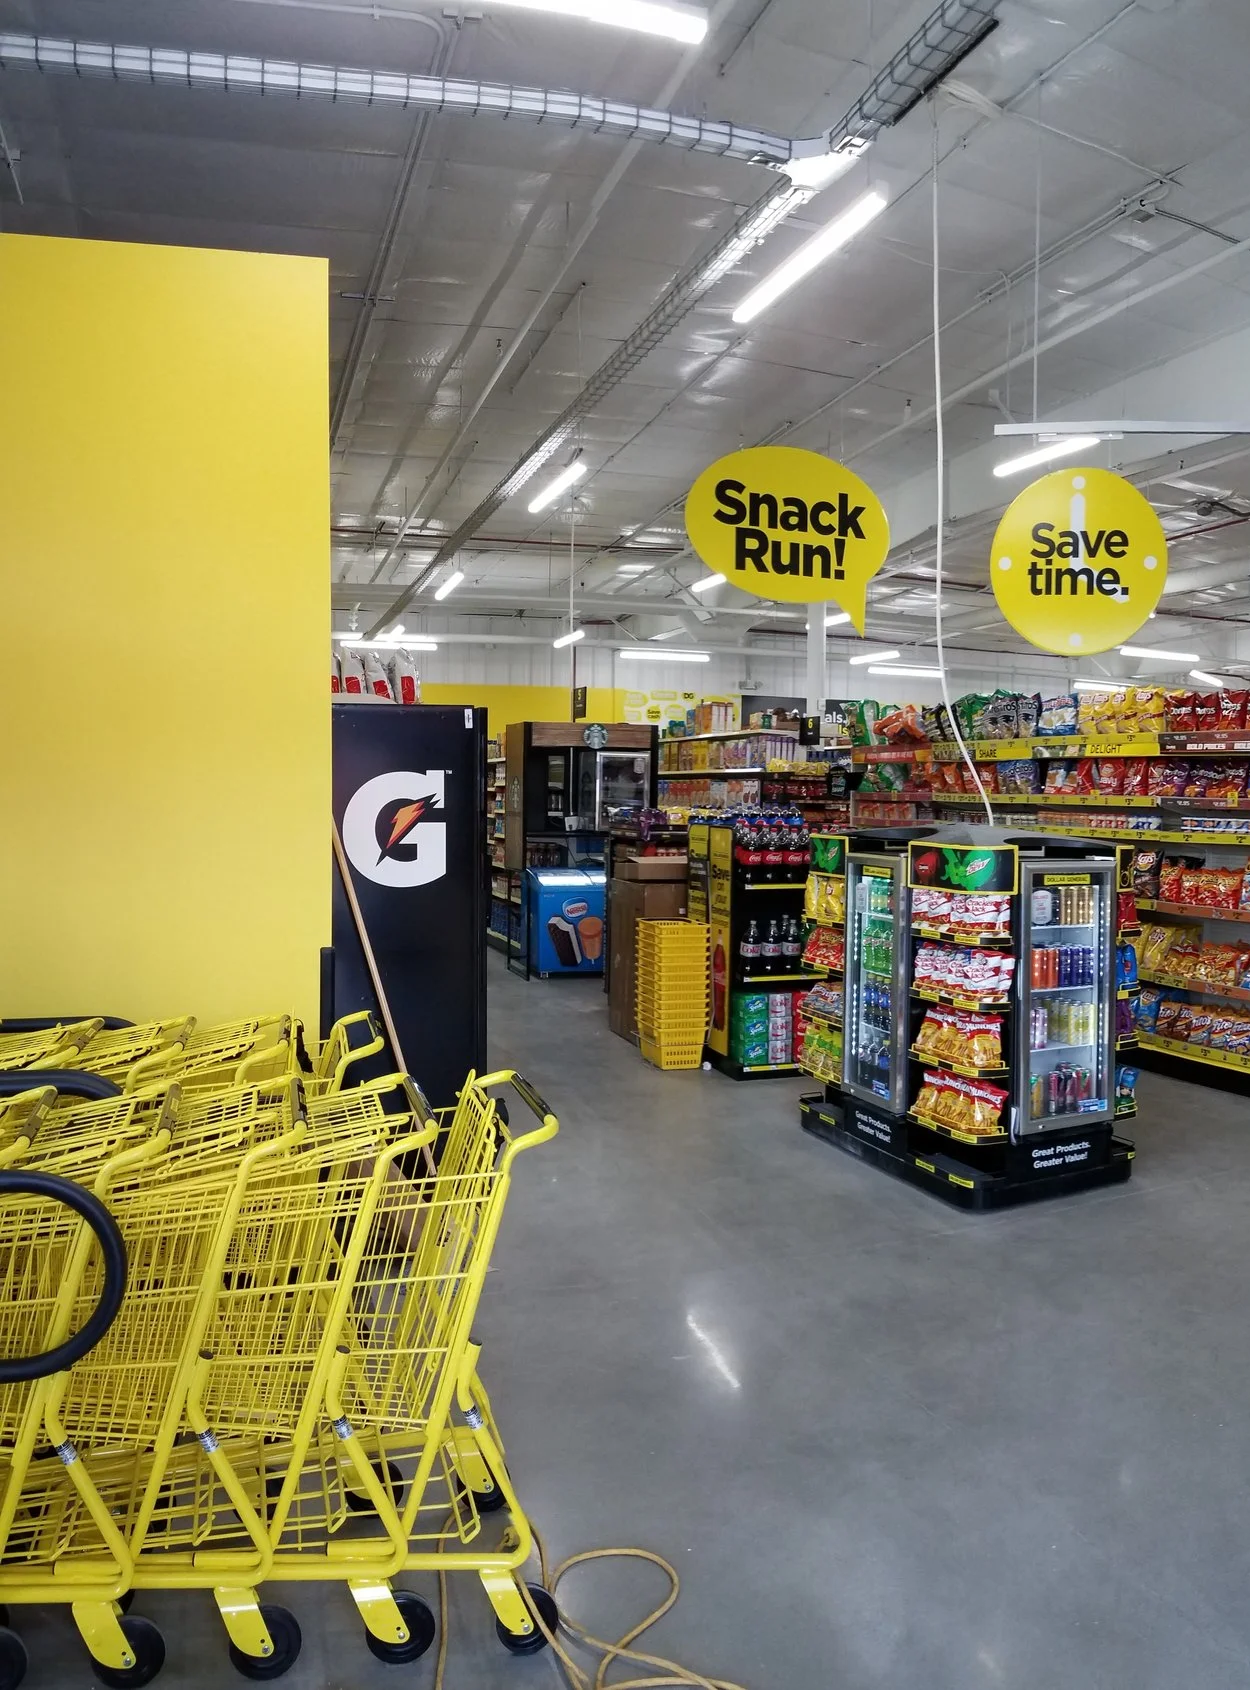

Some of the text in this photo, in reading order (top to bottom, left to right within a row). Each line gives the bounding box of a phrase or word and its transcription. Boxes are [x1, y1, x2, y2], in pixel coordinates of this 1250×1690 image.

[713, 478, 867, 539] Snack
[1031, 523, 1129, 559] Save
[735, 527, 846, 580] Run!
[1028, 558, 1130, 596] time.
[979, 748, 997, 758] SHARE
[1090, 744, 1122, 753] DELIGHT
[343, 770, 447, 888] G
[712, 864, 730, 881] Save
[855, 1110, 892, 1133] Great Products.
[857, 1121, 891, 1143] Greater Value!
[1031, 1141, 1091, 1158] Great Products.
[1033, 1151, 1088, 1169] Greater Value!
